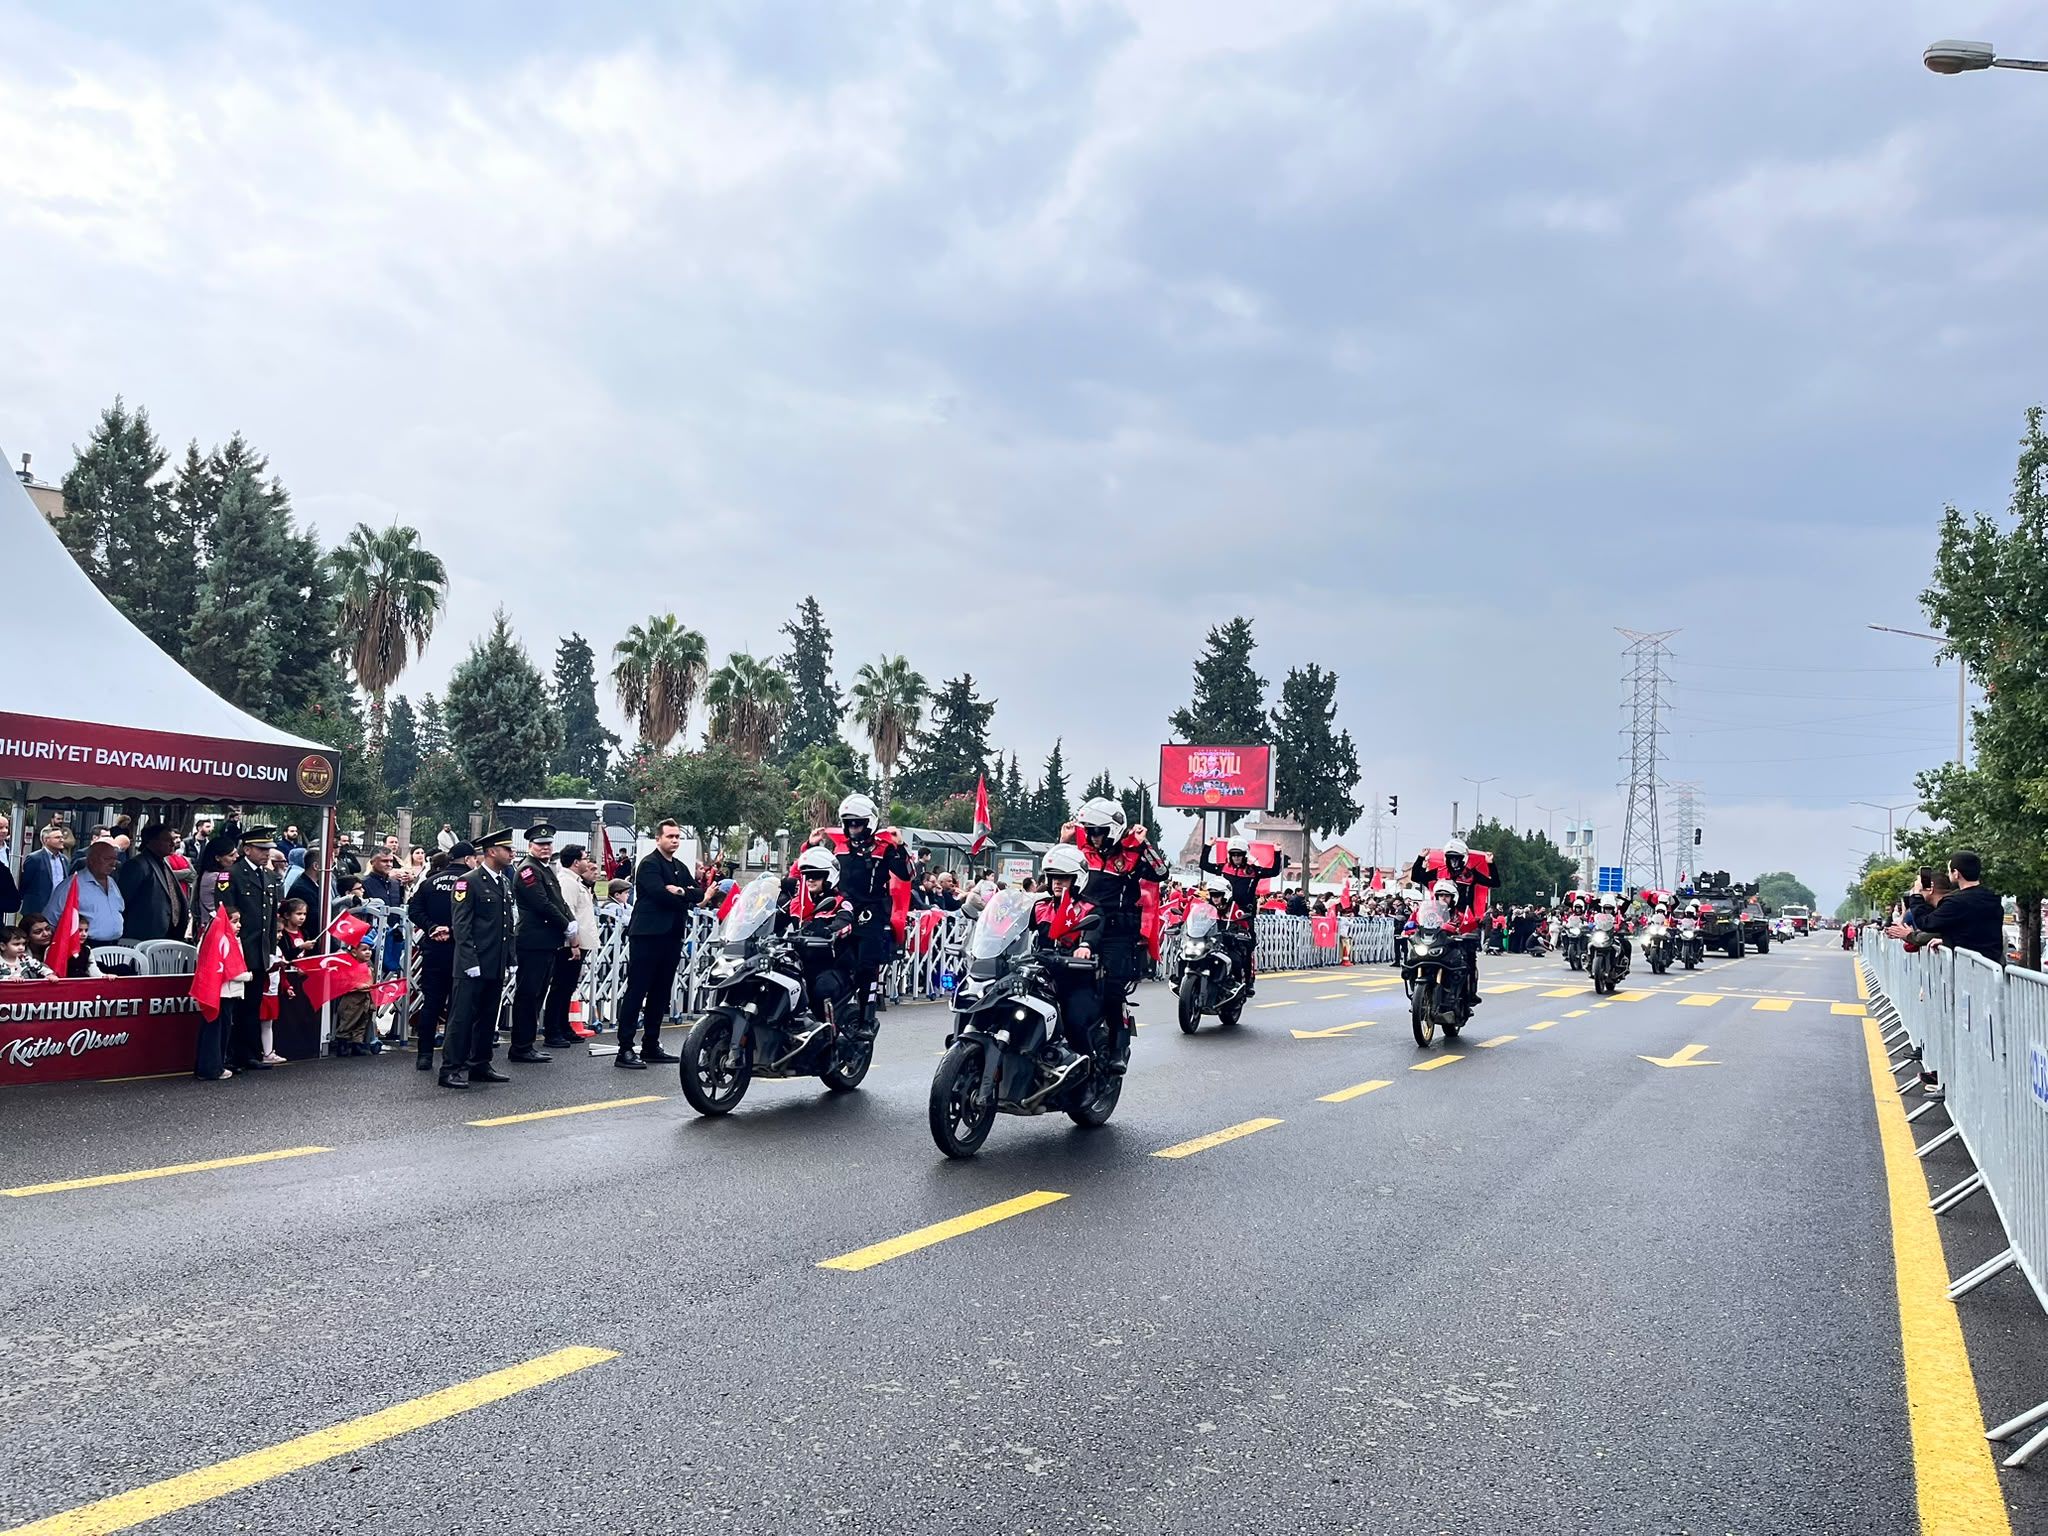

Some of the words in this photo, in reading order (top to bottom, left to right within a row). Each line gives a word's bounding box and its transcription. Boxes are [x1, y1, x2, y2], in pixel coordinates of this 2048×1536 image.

[0, 738, 92, 763] HURİYET
[95, 748, 175, 772] BAYRAMI
[178, 757, 233, 777] KUTLU
[236, 763, 288, 782] OLSUN
[0, 995, 142, 1023] CUMHURİYET
[2, 1036, 64, 1067] Kutlu
[66, 1028, 130, 1057] Olsun
